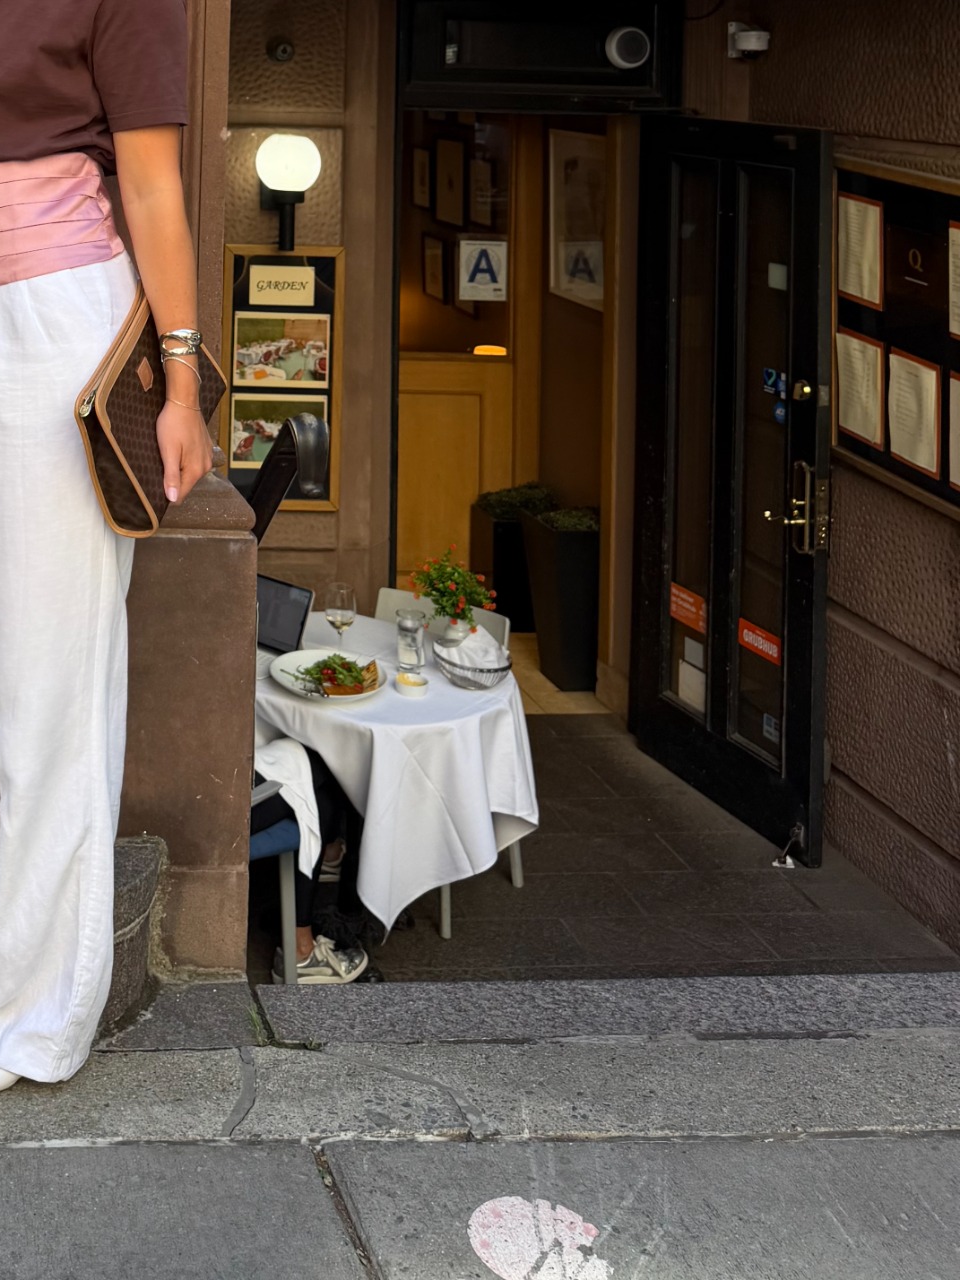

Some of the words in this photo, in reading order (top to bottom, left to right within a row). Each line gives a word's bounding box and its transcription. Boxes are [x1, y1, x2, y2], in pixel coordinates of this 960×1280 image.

[468, 248, 498, 283] A
[908, 248, 924, 273] Q
[256, 280, 309, 292] GARDEN
[742, 628, 779, 658] GRUBHUB
